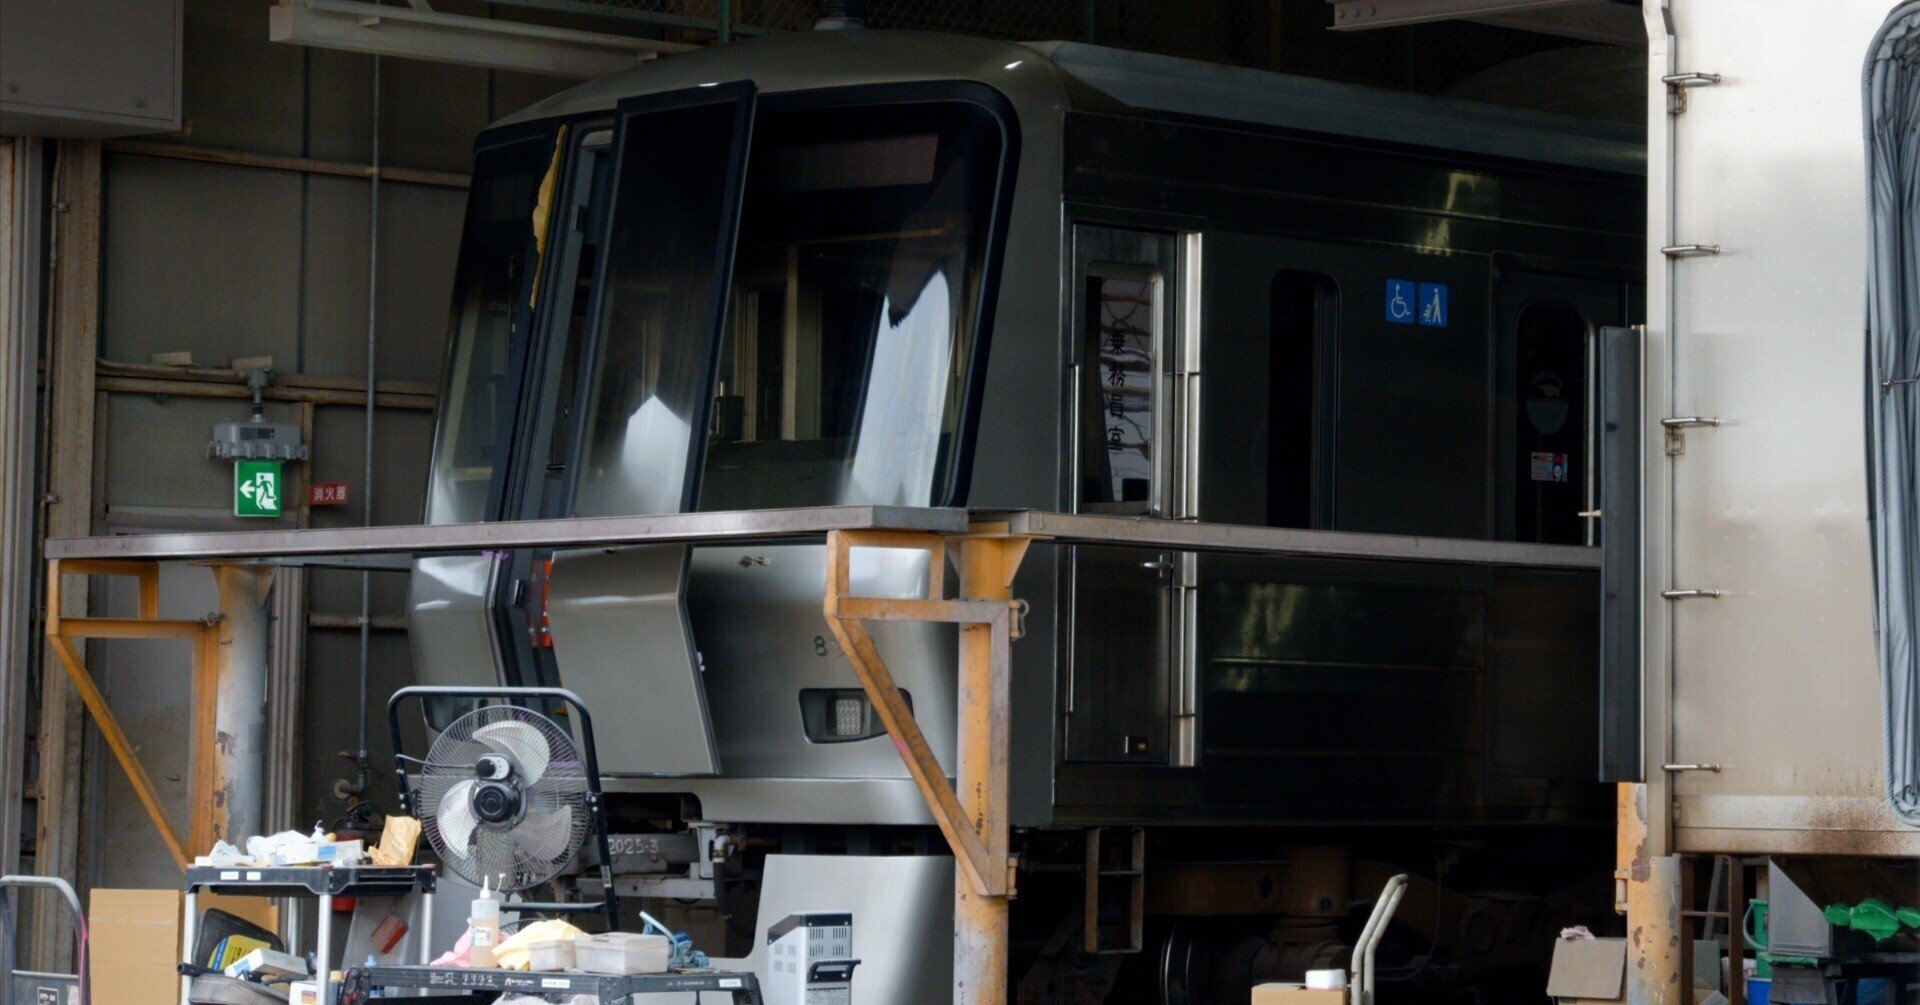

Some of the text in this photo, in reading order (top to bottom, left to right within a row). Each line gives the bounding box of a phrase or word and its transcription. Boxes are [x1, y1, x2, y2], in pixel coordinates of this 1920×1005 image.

[1108, 330, 1126, 451] 乗務員室
[313, 485, 347, 502] 消火器
